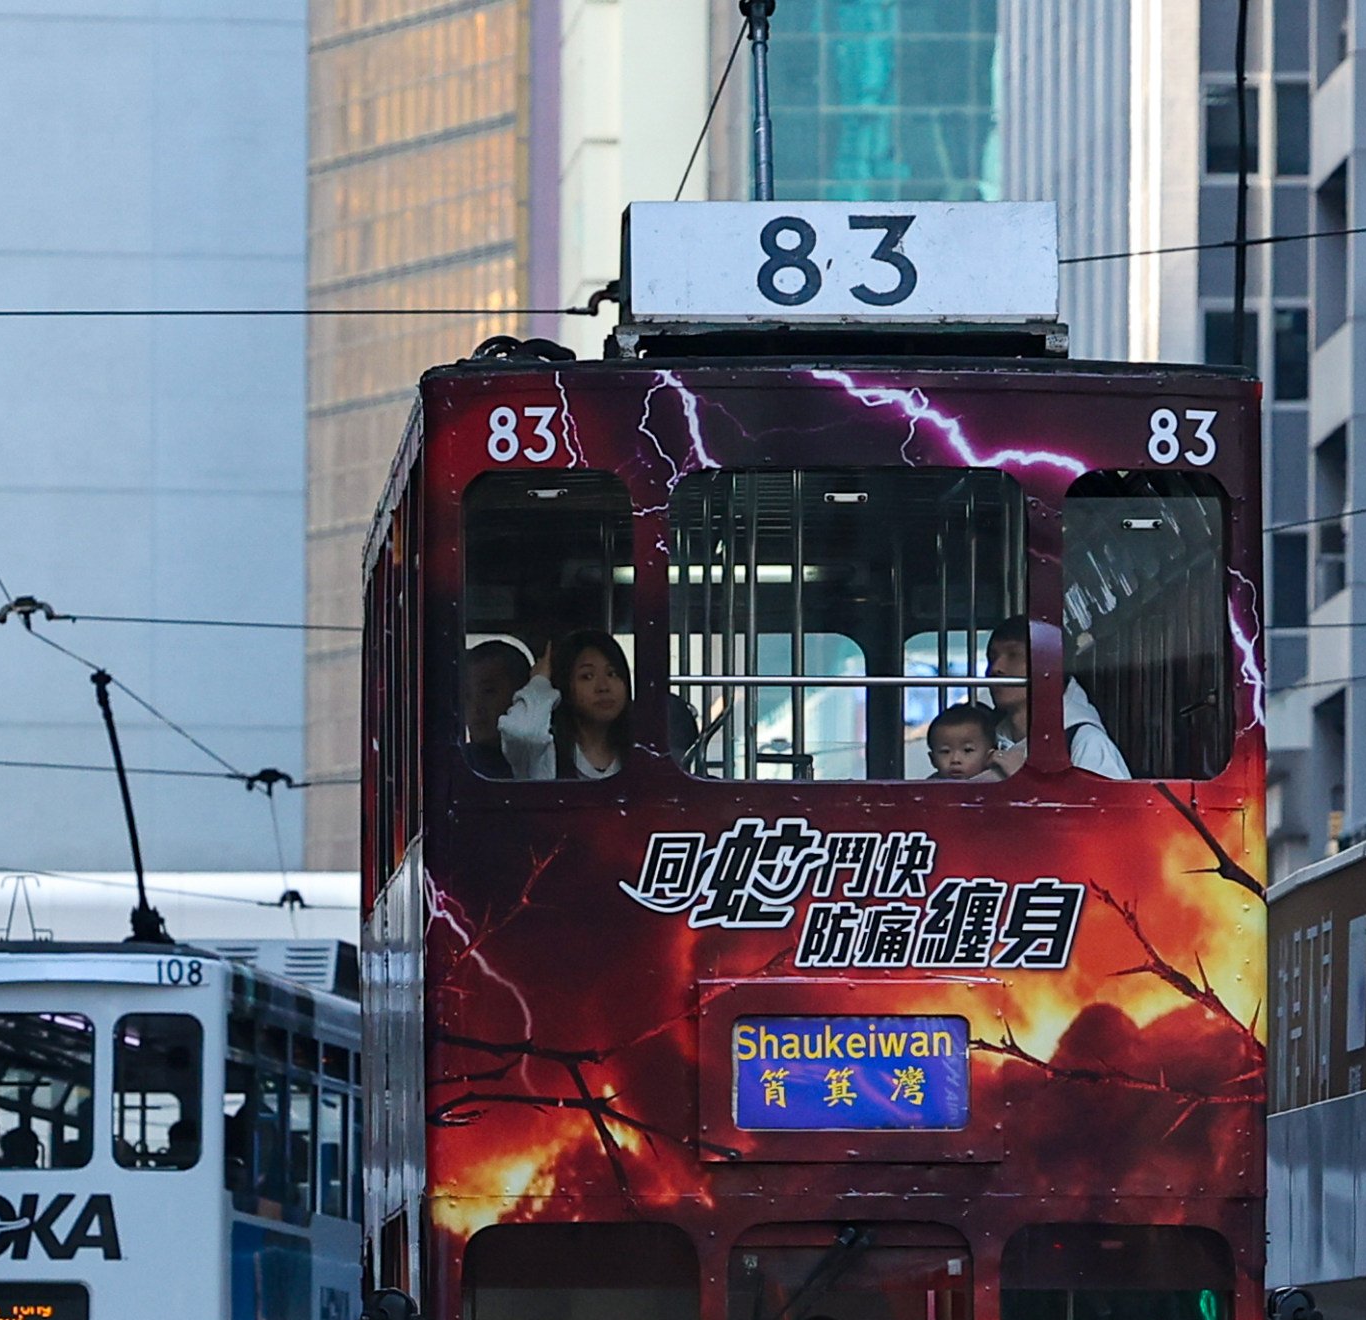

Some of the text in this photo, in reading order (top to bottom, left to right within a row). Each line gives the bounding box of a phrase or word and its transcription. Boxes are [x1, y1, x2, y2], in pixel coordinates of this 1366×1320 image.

[756, 214, 918, 307] 83
[486, 405, 557, 462] 83
[1147, 408, 1218, 466] 83
[795, 877, 1087, 969] 防痛纏身
[157, 959, 204, 987] 108
[737, 1024, 952, 1061] Shaukeiwan
[760, 1066, 926, 1109] 筲箕灣
